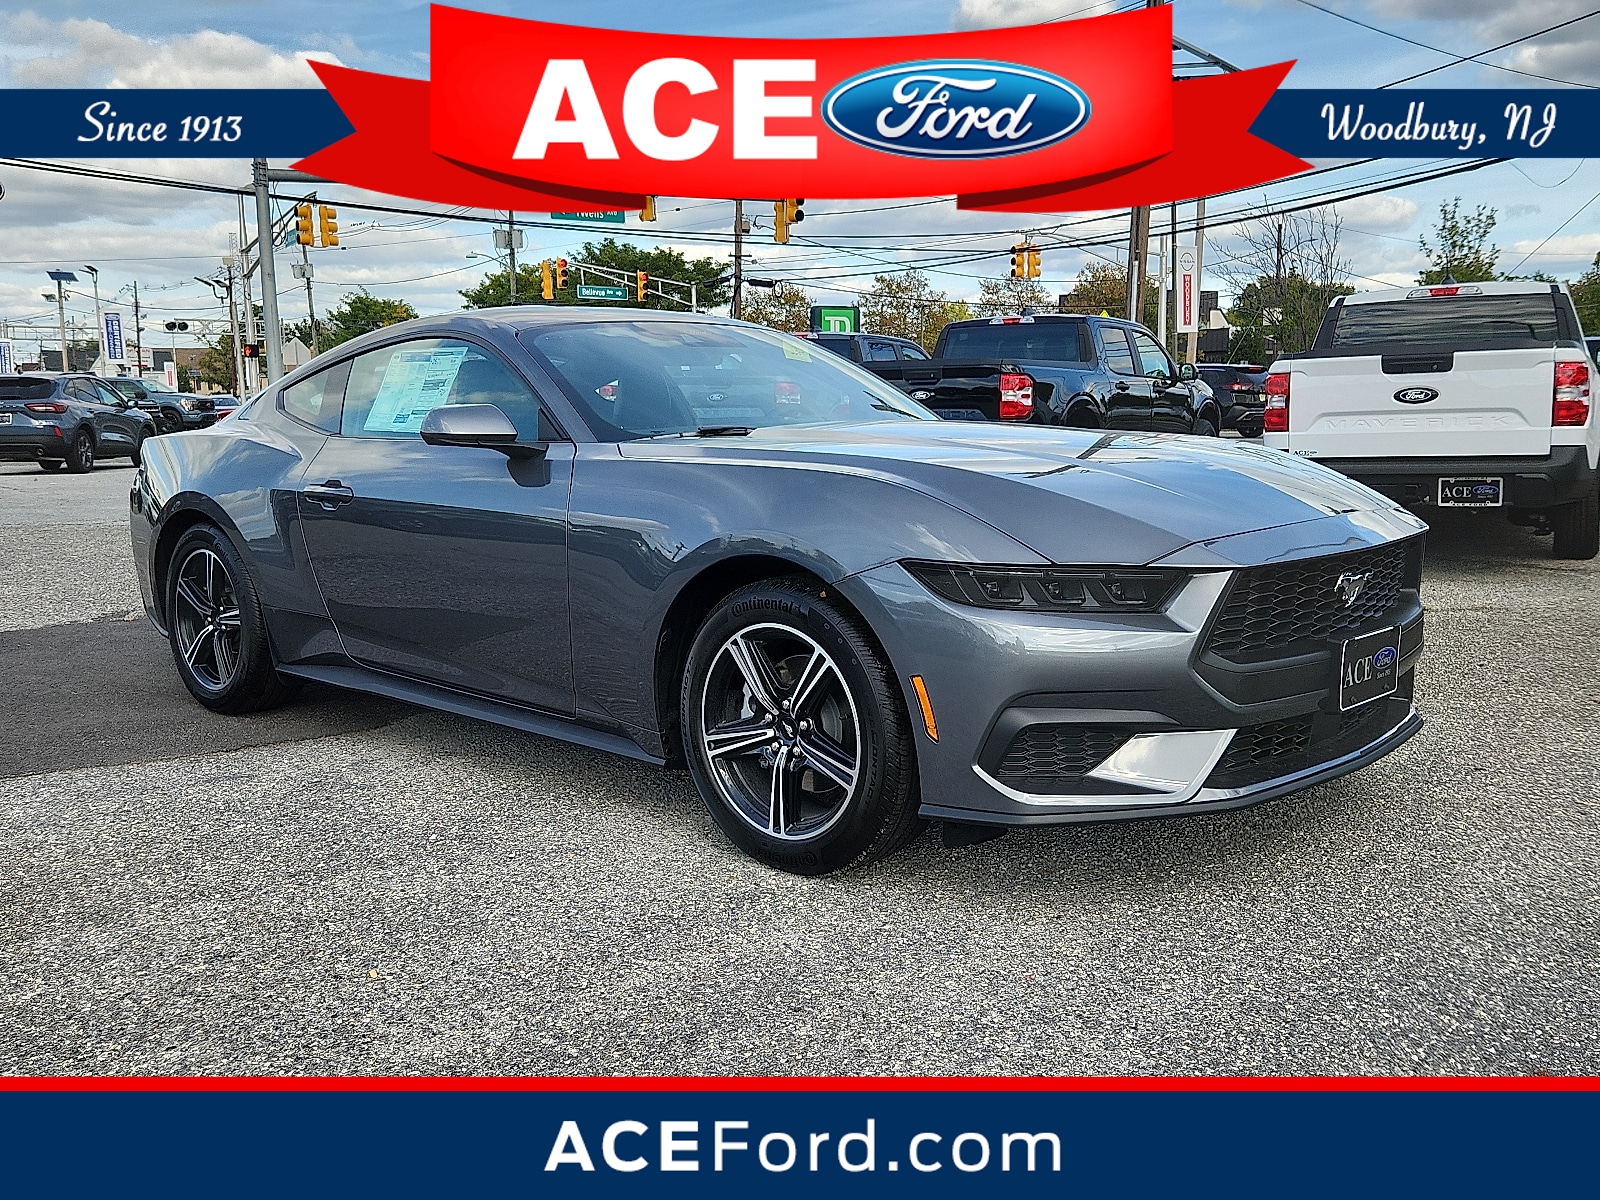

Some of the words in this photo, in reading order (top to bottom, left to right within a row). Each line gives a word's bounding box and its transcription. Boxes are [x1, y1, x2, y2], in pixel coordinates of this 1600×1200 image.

[824, 316, 851, 333] TD
[112, 320, 122, 359] CERTIFIED
[1325, 416, 1509, 430] MAVERICK
[1442, 486, 1472, 498] ACE
[731, 595, 796, 617] Continental
[1344, 656, 1373, 689] ACE
